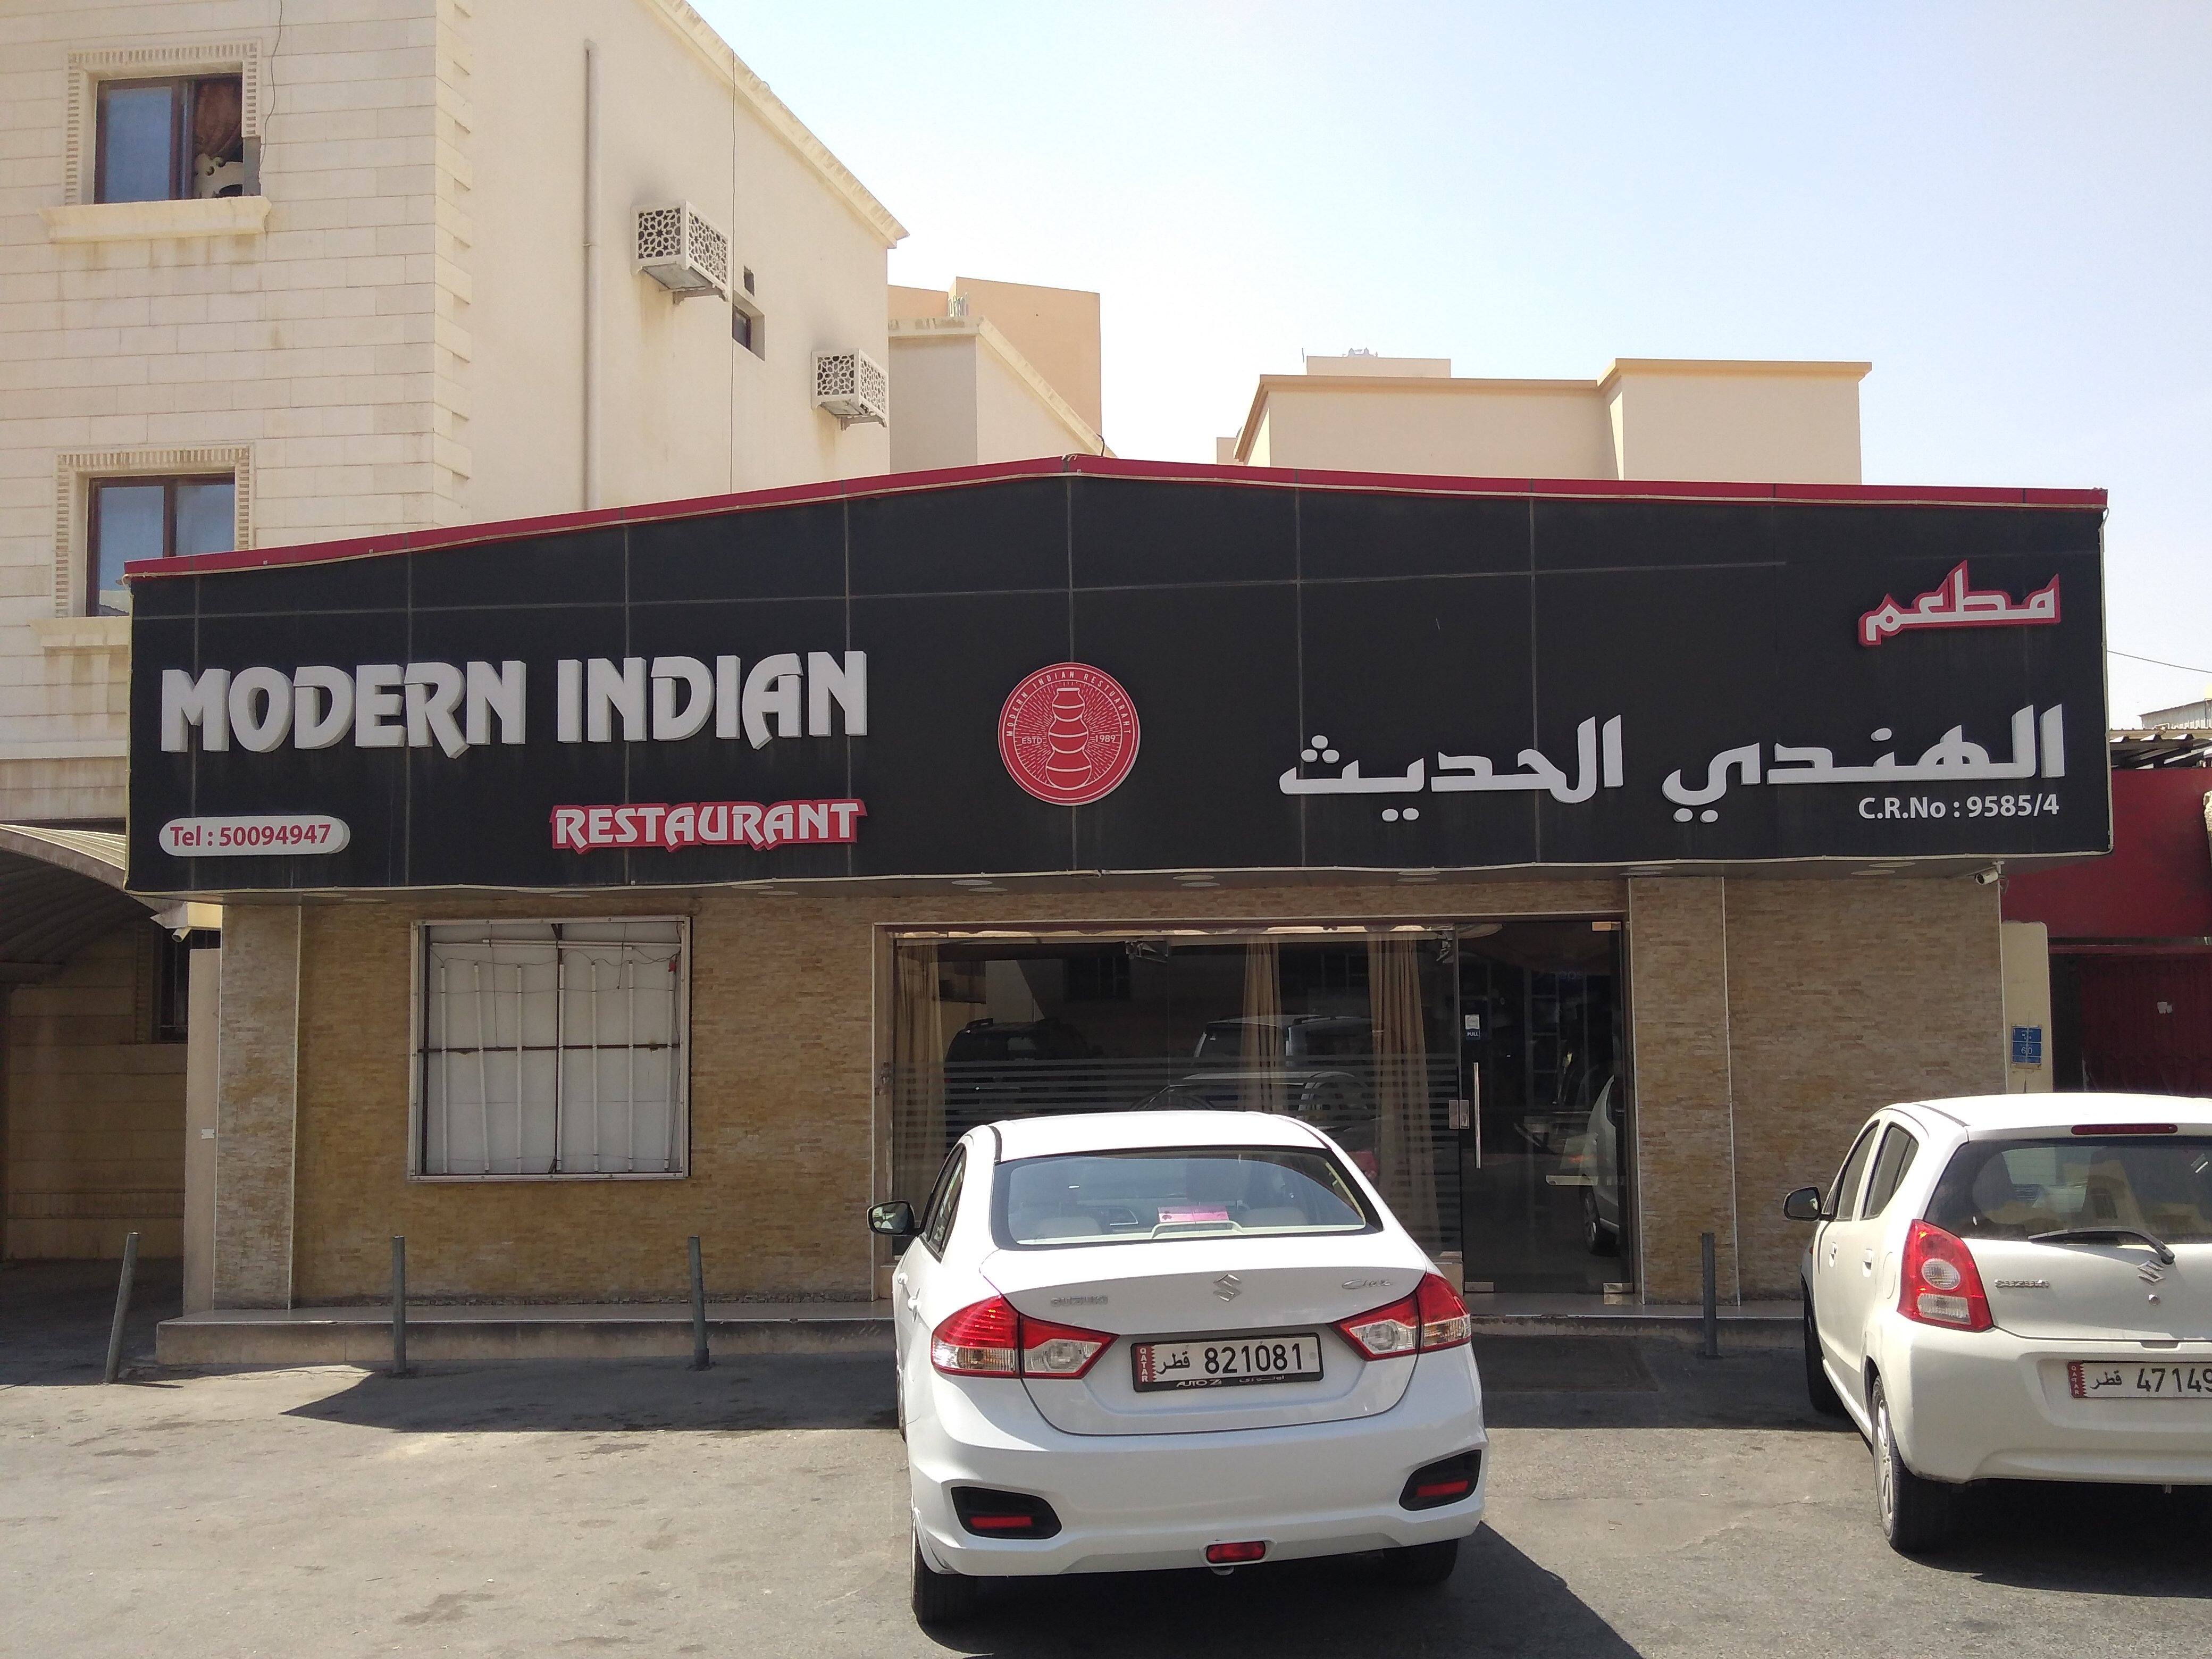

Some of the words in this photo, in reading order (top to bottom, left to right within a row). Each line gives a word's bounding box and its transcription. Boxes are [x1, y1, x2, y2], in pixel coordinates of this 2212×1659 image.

[1864, 565, 2057, 642] مطعم
[161, 660, 526, 759] MODERN
[557, 650, 867, 750] INDIAN
[1006, 692, 1028, 737] MODERN
[1032, 671, 1075, 689] INDIAN
[1021, 736, 1043, 745] ESTD
[1094, 734, 1116, 743] 1989
[1279, 714, 1623, 822] الحديث
[1662, 703, 2065, 823] الهندي
[1966, 793, 2060, 818] 9585/4
[219, 824, 331, 847] 50094947
[555, 802, 860, 850] RESTAURANT
[1139, 1347, 1149, 1382] QATAR
[1156, 1351, 1191, 1375] قطر
[1204, 1343, 1302, 1375] 821081
[2090, 1370, 2123, 1390] قطر
